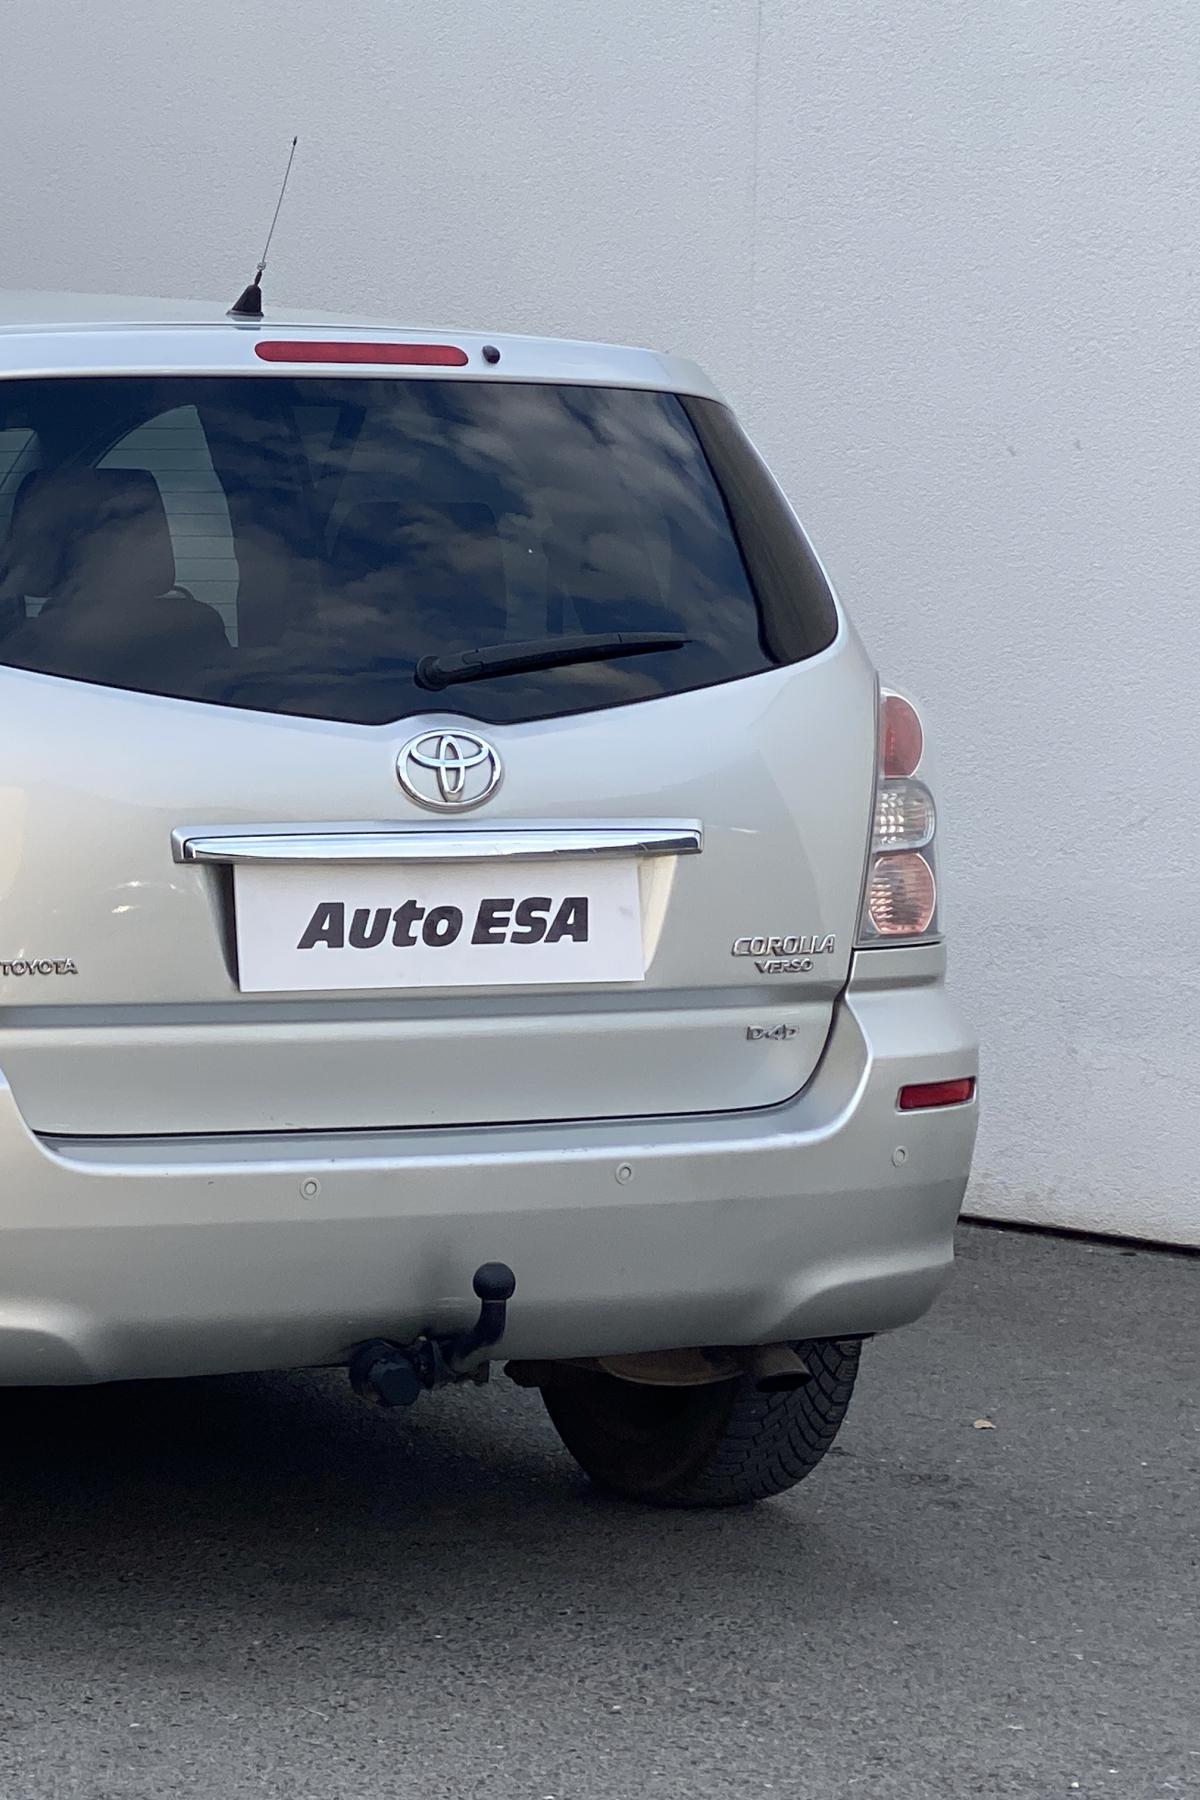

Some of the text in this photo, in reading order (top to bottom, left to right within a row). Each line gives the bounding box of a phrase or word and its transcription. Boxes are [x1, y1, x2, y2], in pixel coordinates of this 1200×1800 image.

[297, 897, 589, 949] Auto ESA
[732, 934, 836, 956] COROLLA
[0, 959, 78, 976] TOYOTA
[754, 959, 813, 974] VERSO
